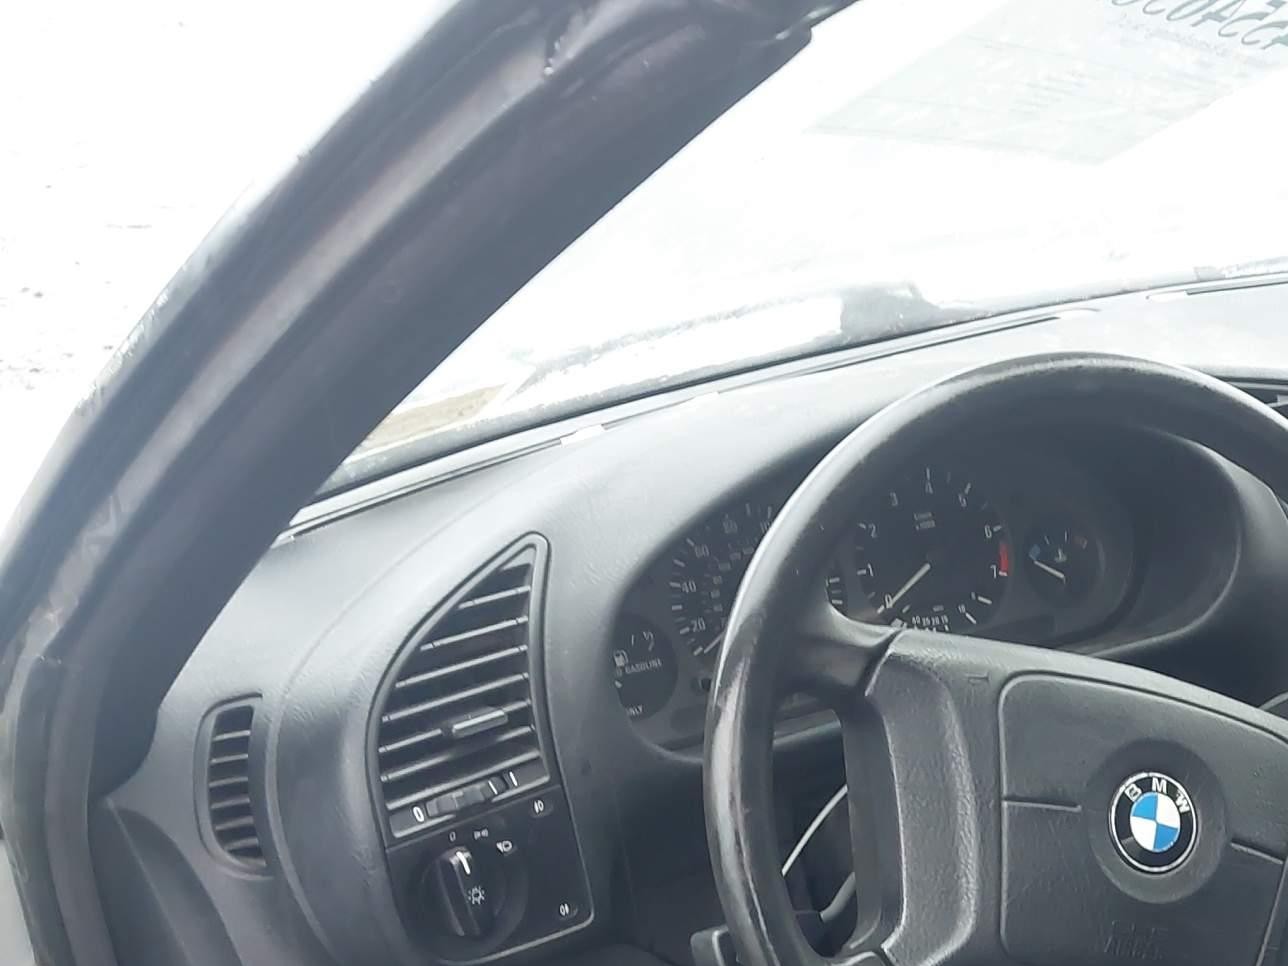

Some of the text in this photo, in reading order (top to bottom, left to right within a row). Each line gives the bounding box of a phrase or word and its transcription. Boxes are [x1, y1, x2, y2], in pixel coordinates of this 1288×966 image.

[868, 523, 878, 539] 2
[681, 580, 697, 594] 40
[691, 618, 706, 633] 20
[1124, 776, 1191, 814] BMW
